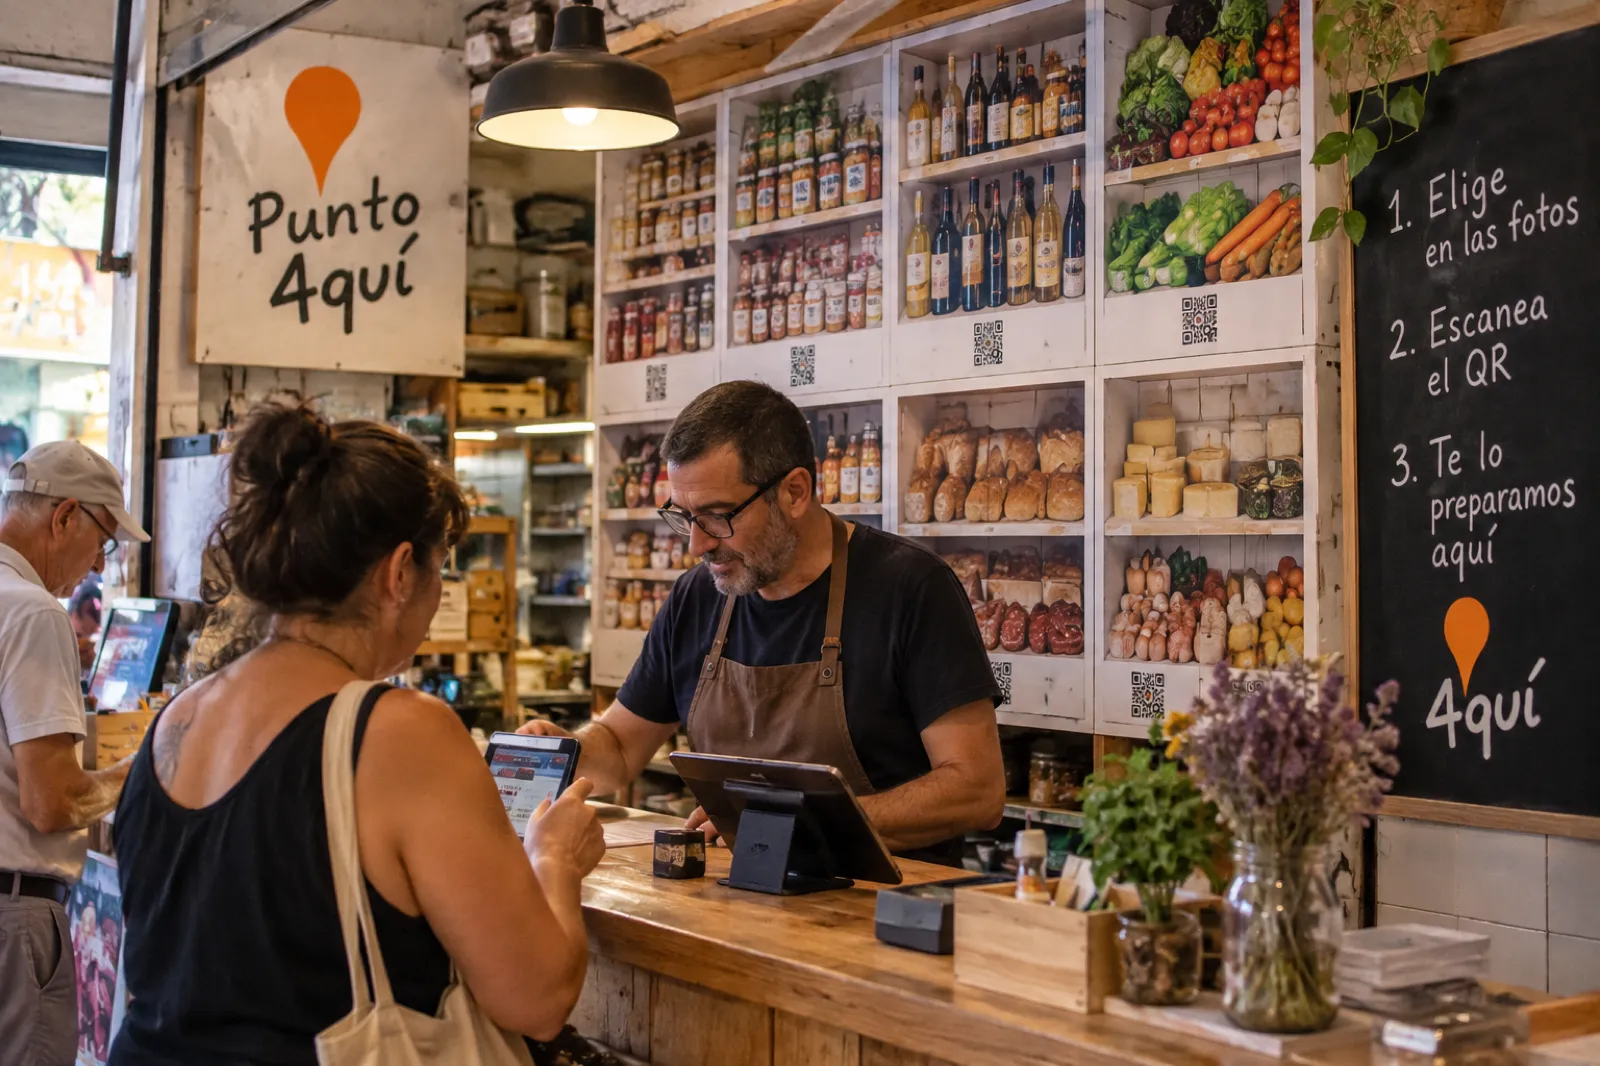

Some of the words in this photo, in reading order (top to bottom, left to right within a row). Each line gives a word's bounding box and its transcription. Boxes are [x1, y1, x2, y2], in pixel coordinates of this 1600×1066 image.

[247, 175, 421, 255] Punto
[1388, 188, 1412, 234] 1.
[1428, 167, 1508, 220] Elige
[1425, 239, 1454, 268] en
[1463, 220, 1498, 257] las
[1507, 192, 1580, 242] fotos
[1388, 318, 1417, 361] 2.
[1429, 294, 1549, 350] Escanea
[1427, 356, 1450, 397] el
[1465, 342, 1513, 388] QR
[1390, 443, 1419, 487] 3.
[1428, 434, 1463, 479] Te
[1479, 430, 1504, 471] lo
[1430, 477, 1577, 536] preparamos
[1430, 522, 1499, 584] aquí
